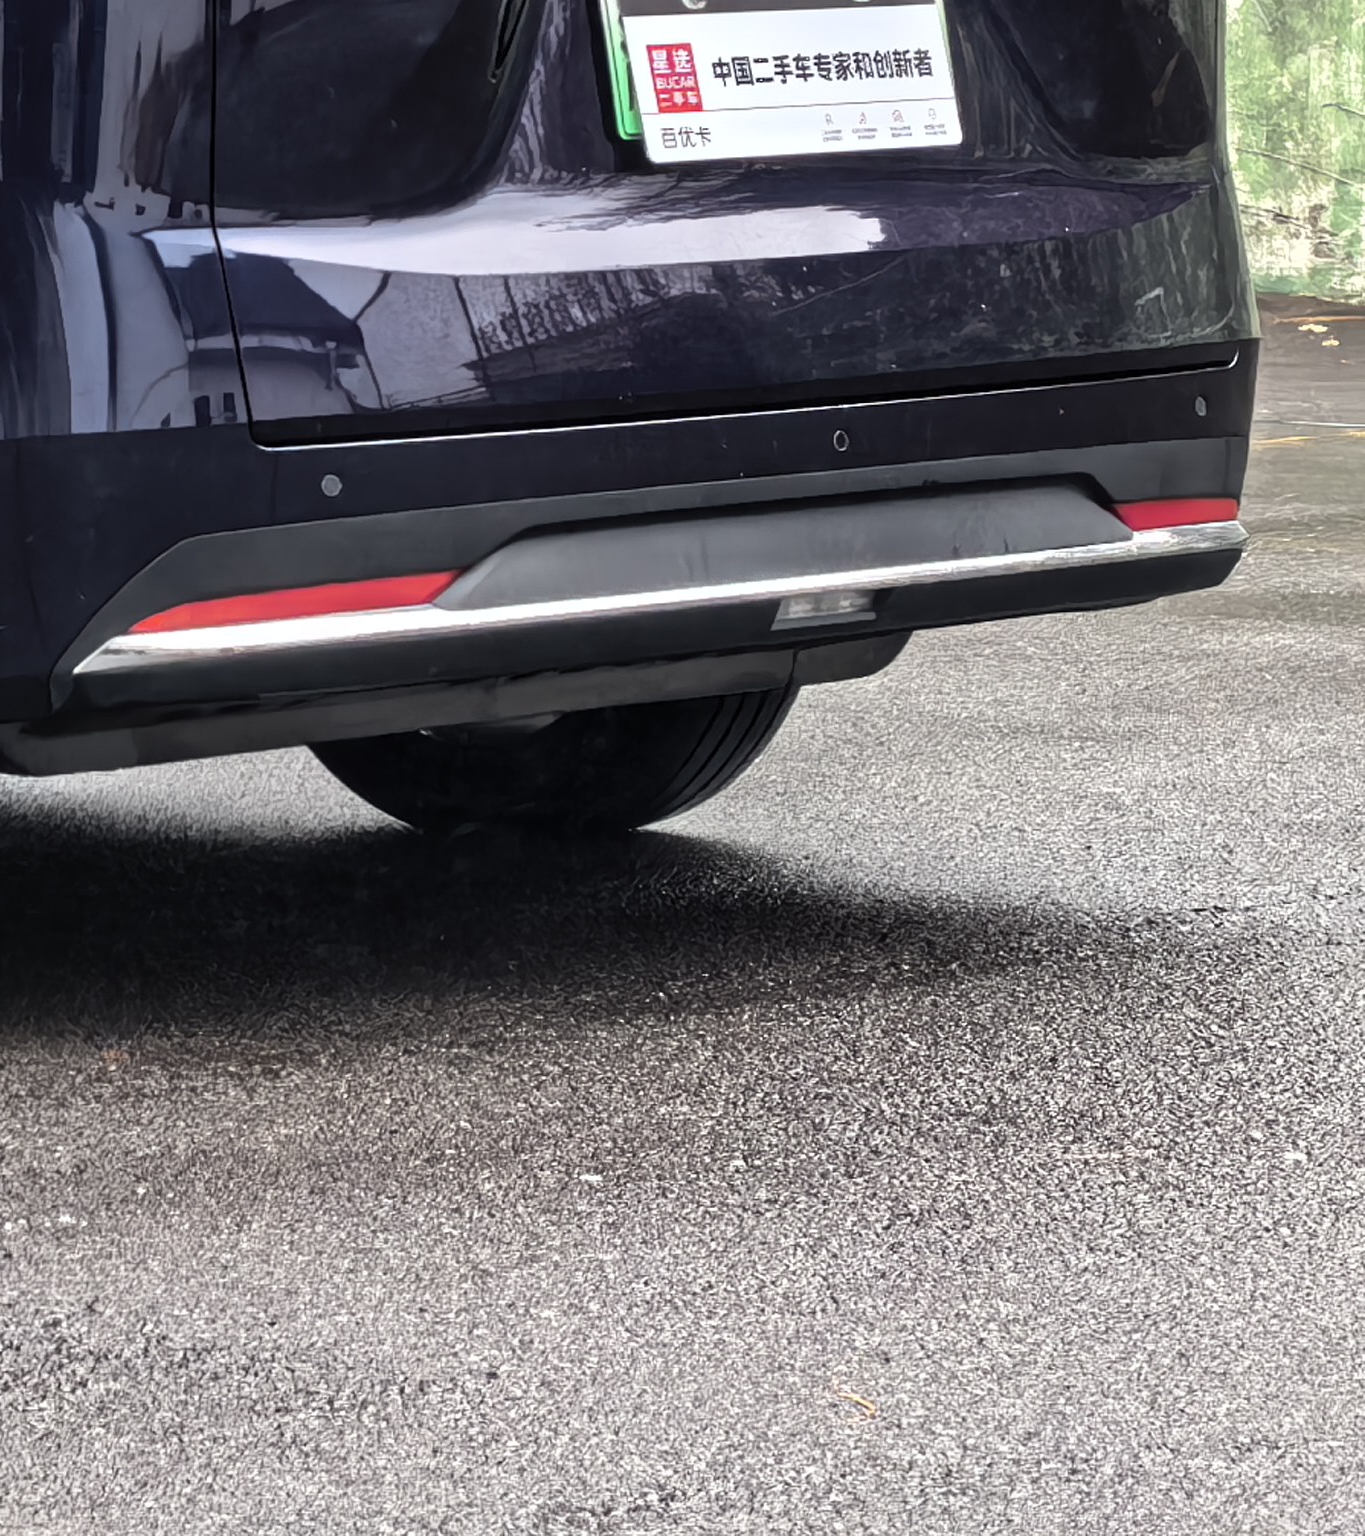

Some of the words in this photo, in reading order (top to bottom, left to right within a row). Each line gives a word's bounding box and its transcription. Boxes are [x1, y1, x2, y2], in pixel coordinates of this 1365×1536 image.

[652, 49, 693, 74] 星选
[711, 48, 934, 87] 中国二手车专家和创新者
[655, 76, 696, 90] BUCAR
[660, 126, 712, 149] 百优卡
